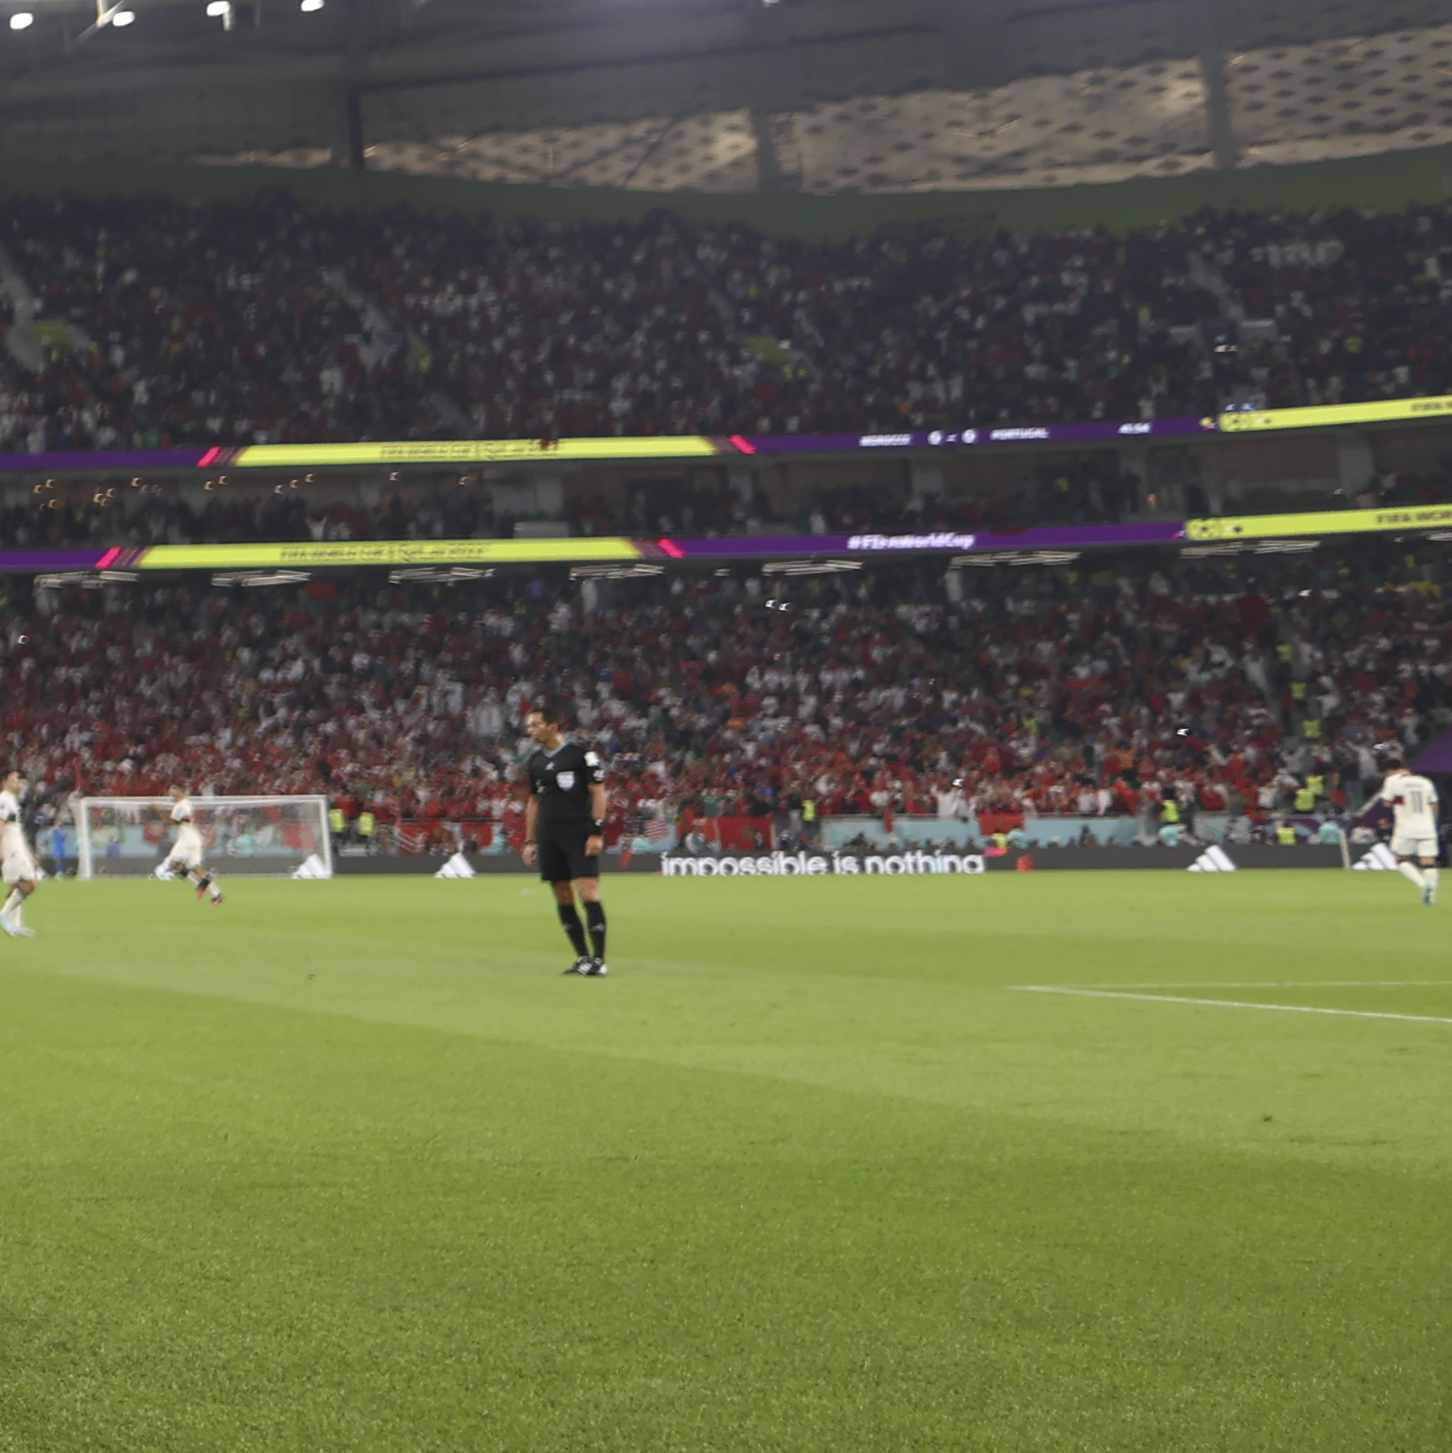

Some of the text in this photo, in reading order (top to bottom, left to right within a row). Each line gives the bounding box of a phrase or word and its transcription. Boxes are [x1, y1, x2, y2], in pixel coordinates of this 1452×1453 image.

[660, 851, 985, 876] impossible is nothing
